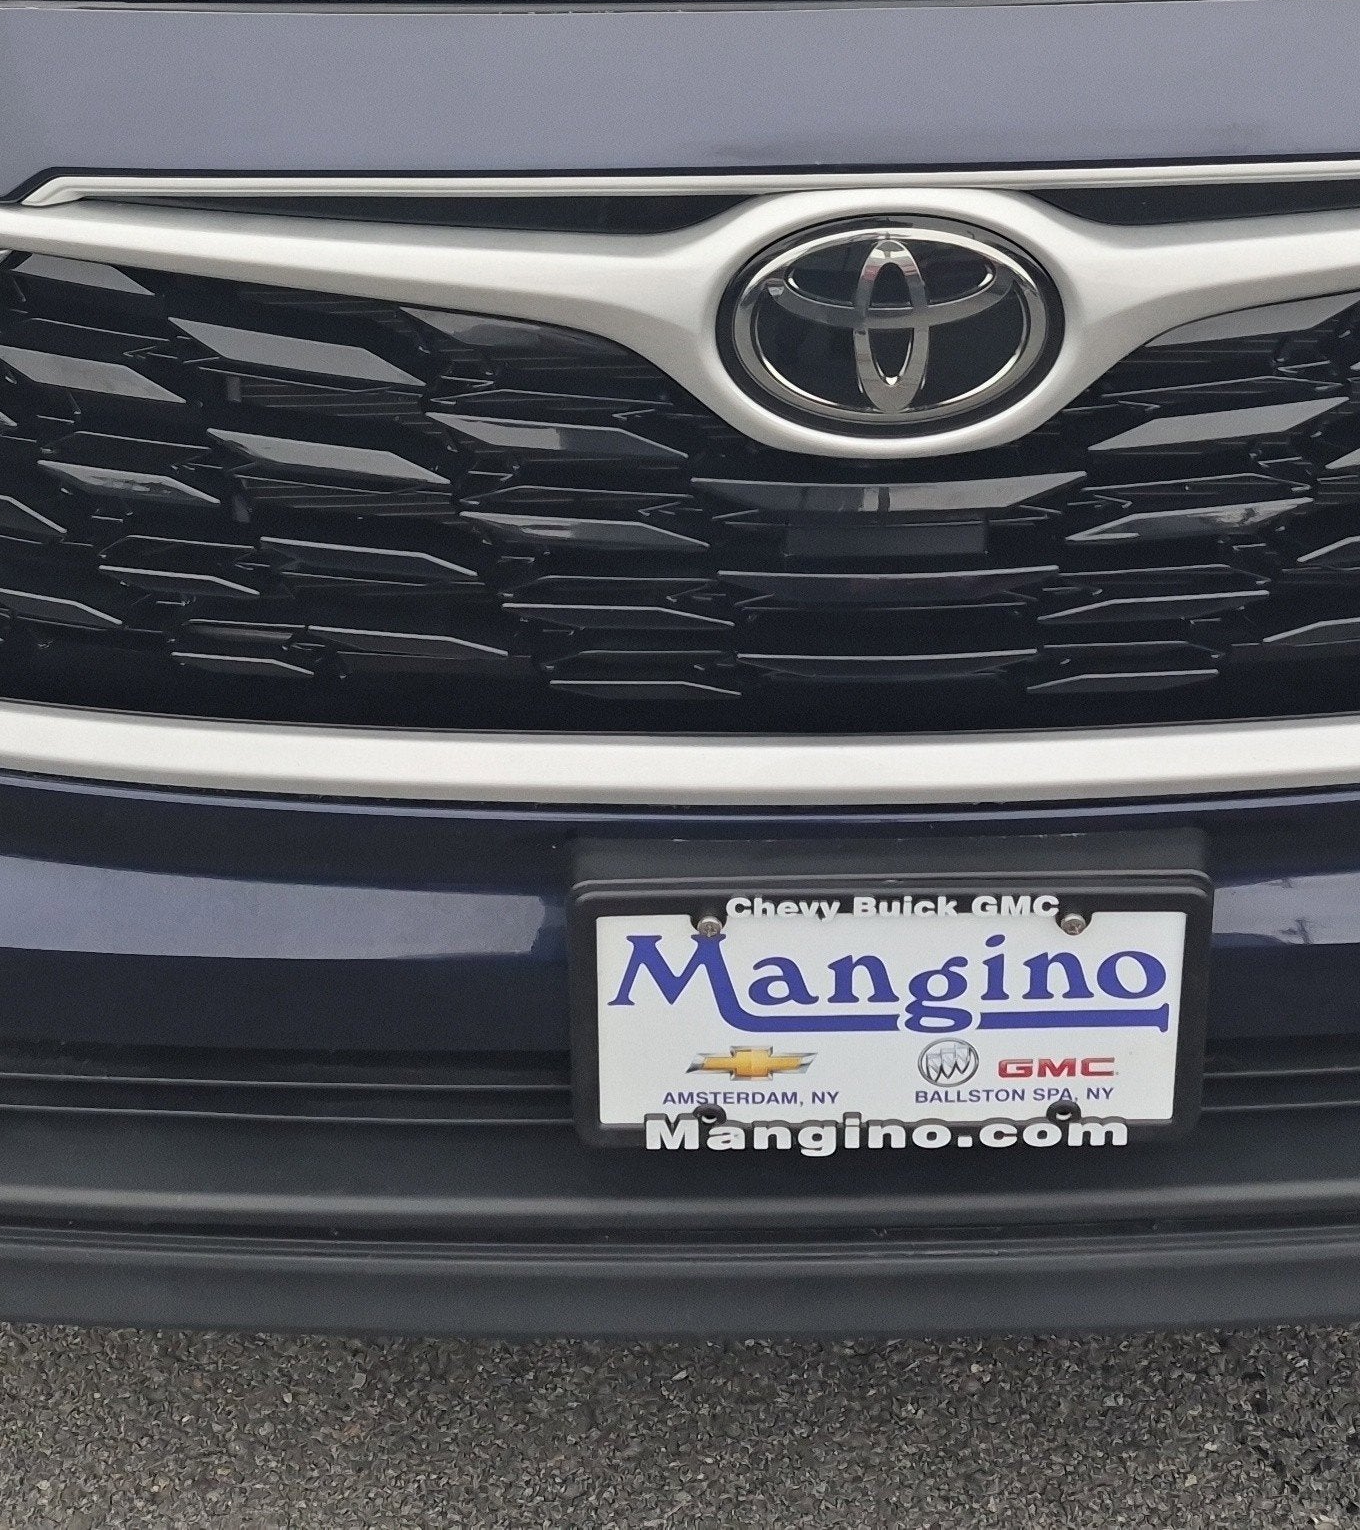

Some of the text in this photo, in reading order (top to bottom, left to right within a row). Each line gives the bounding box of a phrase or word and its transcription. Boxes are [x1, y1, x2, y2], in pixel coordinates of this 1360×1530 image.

[725, 895, 1060, 921] Chevy Buick GMC
[607, 933, 1169, 1034] Mangino
[997, 1056, 1116, 1079] GMC
[662, 1090, 840, 1107] AMSTERDAM, NY
[914, 1087, 1115, 1104] BALLSTON SPA, NY
[643, 1112, 1128, 1157] Mangino.com
